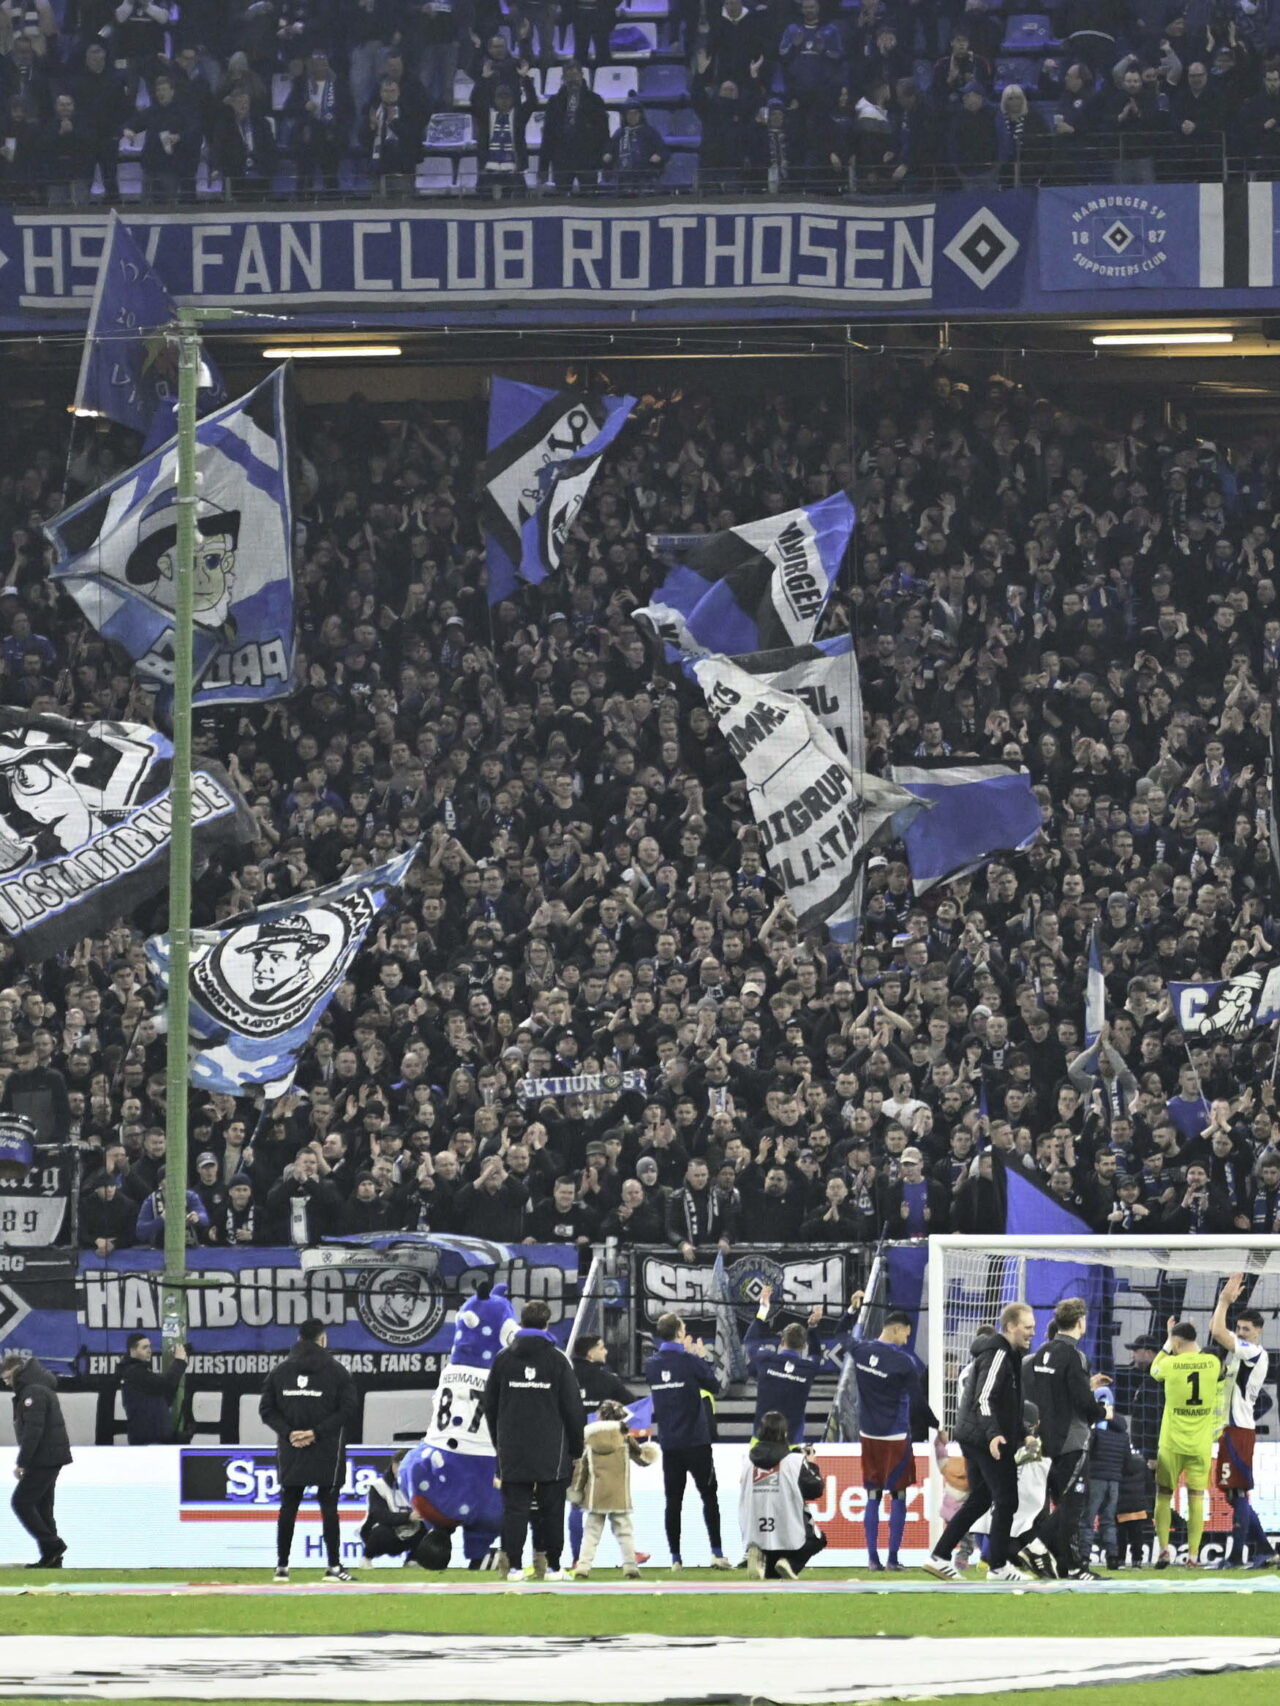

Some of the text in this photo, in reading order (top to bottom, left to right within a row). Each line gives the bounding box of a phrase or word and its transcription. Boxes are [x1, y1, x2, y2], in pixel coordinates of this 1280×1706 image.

[1071, 196, 1167, 223] HAMBURGER SV
[193, 222, 321, 293] FAN
[353, 218, 533, 291] CLUB
[561, 214, 935, 290] ROTHOSEN
[1072, 250, 1168, 278] SUPPORTERS CLUB
[380, 1354, 418, 1374] FANS
[423, 1354, 437, 1373] &
[855, 1363, 888, 1379] HanseMerkur
[1172, 1360, 1208, 1371] HAMBURGER
[766, 1368, 808, 1384] HanseMerkur
[282, 1389, 323, 1398] HanseMerkur
[508, 1380, 552, 1390] HanseMerkur
[1185, 1370, 1204, 1406] 1
[436, 1387, 486, 1434] 87
[1221, 1462, 1232, 1479] 5
[758, 1517, 775, 1533] 23
